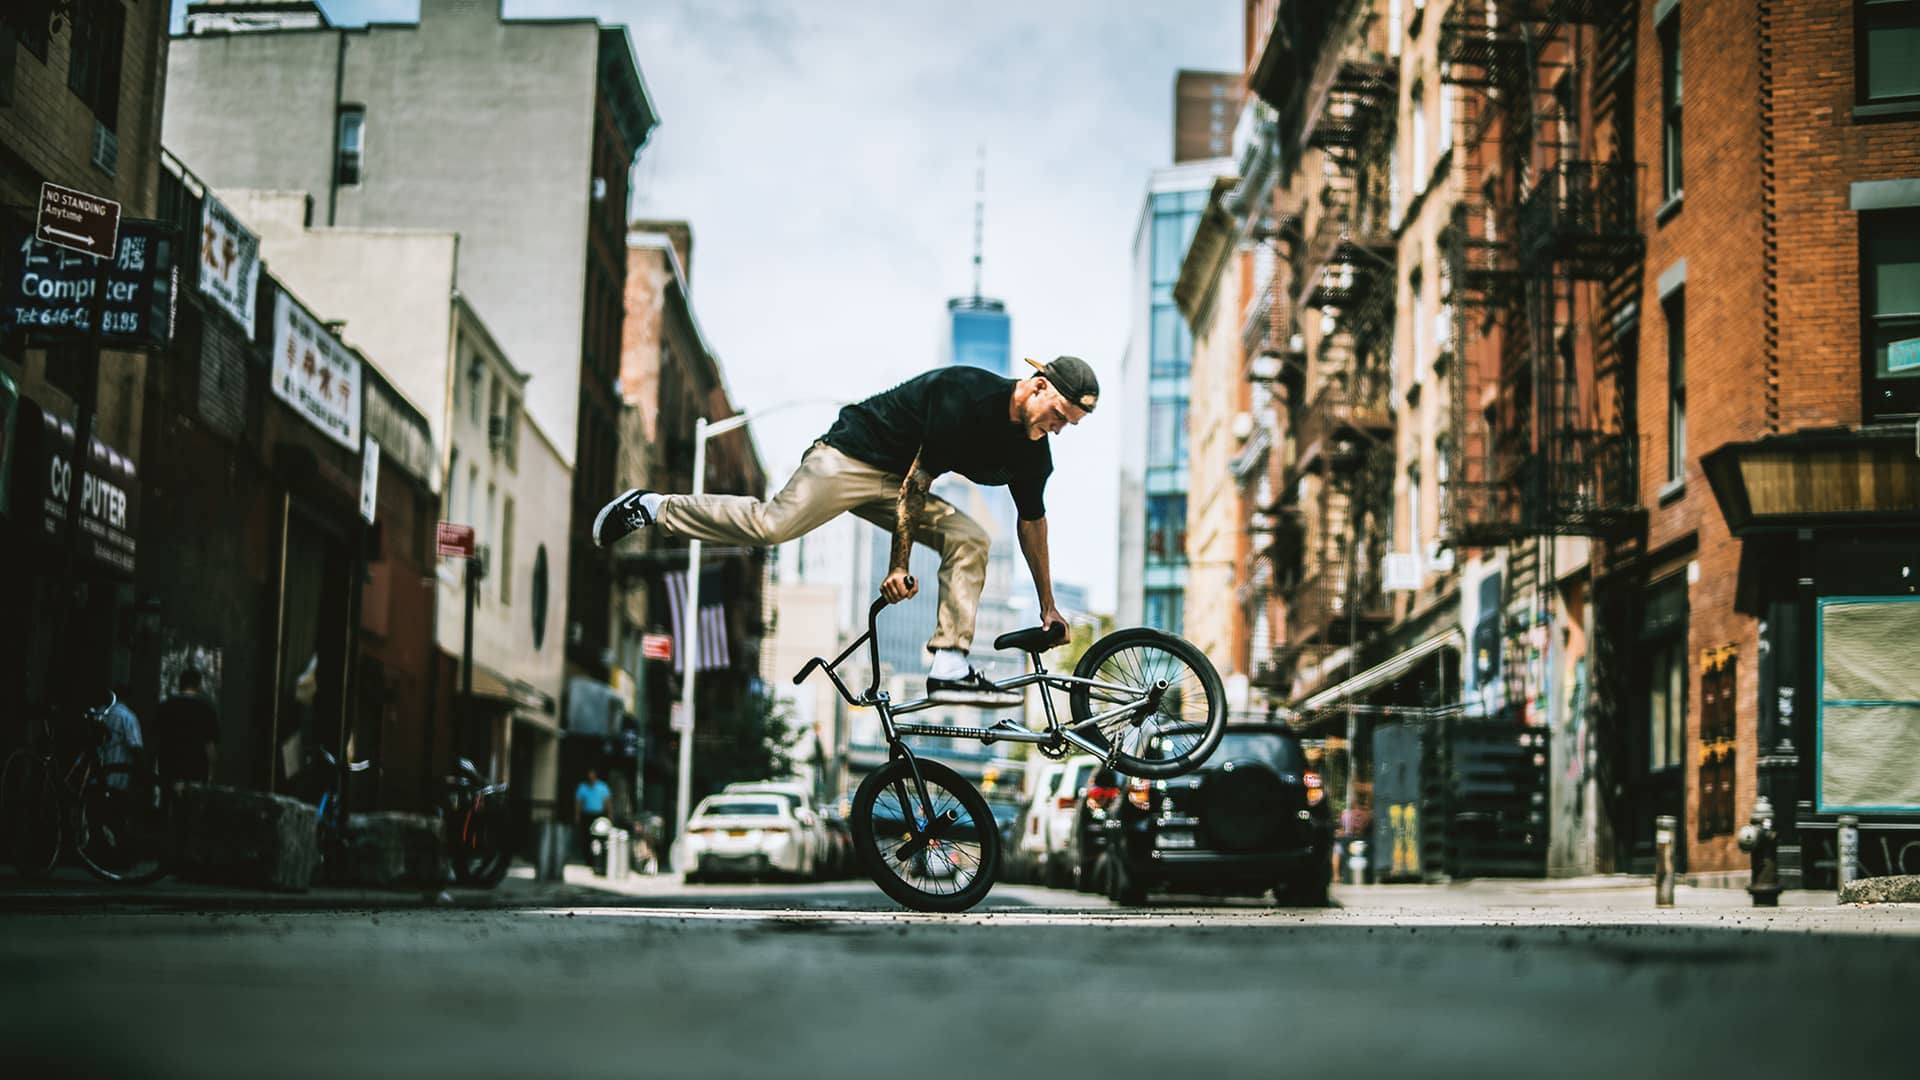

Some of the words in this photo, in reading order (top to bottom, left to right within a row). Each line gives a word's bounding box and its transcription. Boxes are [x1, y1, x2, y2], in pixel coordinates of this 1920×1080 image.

[45, 203, 83, 223] Anytime
[47, 190, 60, 202] NO
[62, 195, 106, 216] STANDING
[51, 455, 126, 529] COPUTER
